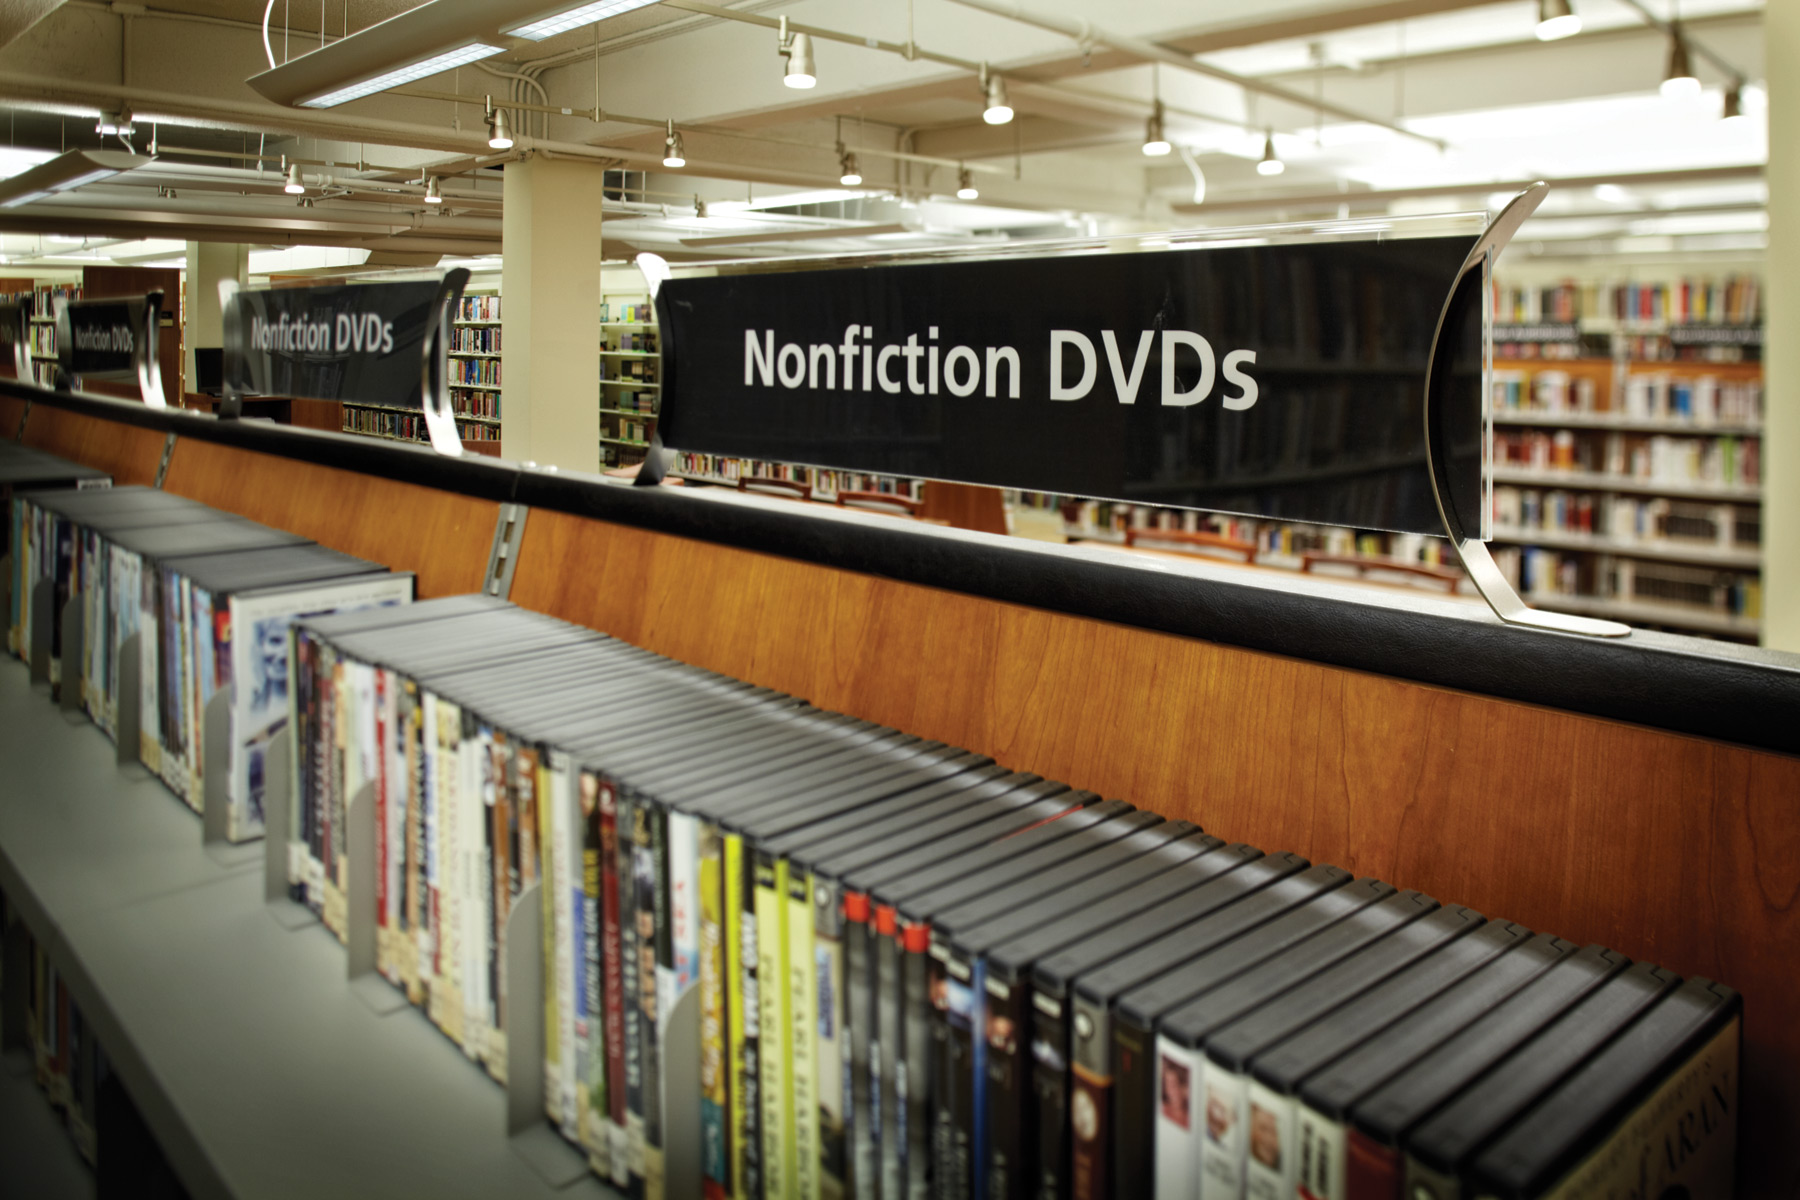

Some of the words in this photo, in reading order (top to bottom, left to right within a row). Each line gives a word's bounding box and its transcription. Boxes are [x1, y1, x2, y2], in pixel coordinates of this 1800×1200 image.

[75, 324, 111, 351] Nonfiction
[112, 325, 133, 353] DVDs
[252, 312, 330, 351] Nonfiction
[335, 313, 394, 353] DVDs
[745, 324, 1020, 399] Nonfiction
[1050, 330, 1259, 410] DVDs
